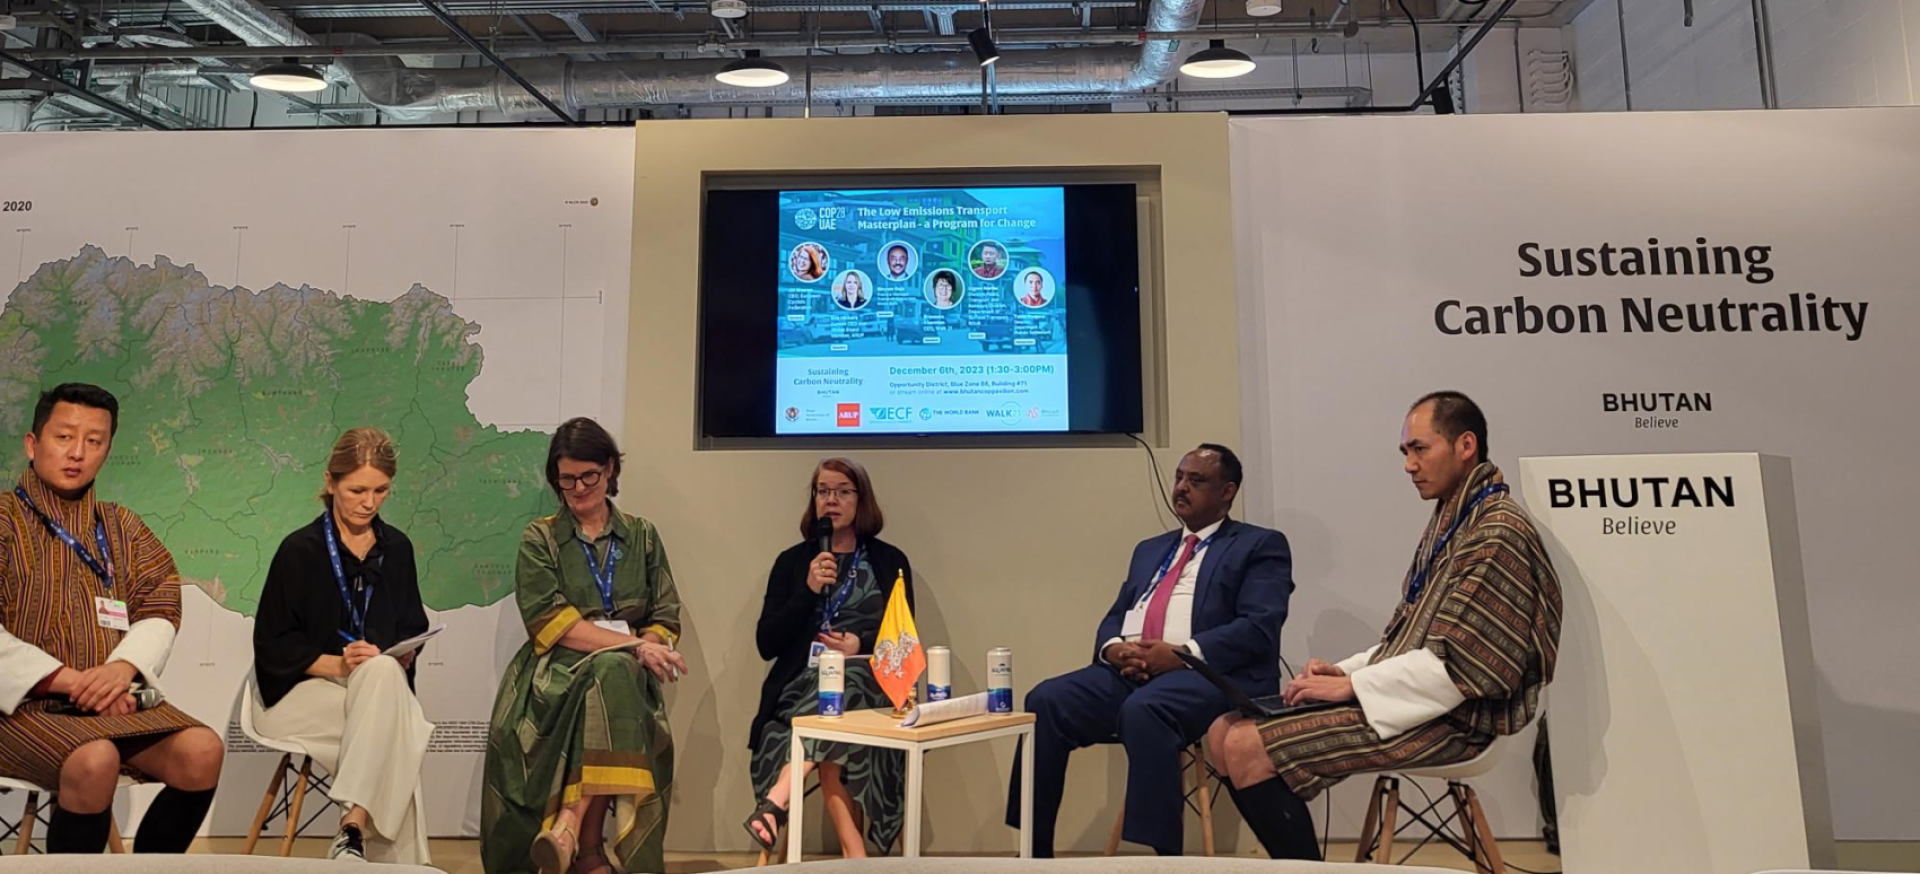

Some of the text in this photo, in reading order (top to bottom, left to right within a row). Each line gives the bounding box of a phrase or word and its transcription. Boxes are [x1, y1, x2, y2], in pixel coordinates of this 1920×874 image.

[2, 201, 33, 212] 2020
[857, 206, 1008, 217] The Low Emissions Transport
[819, 219, 837, 230] UAE
[858, 219, 916, 231] Masterplan
[933, 218, 978, 230] Program
[980, 219, 995, 228] for
[997, 218, 1037, 229] Change
[1517, 236, 1775, 285] Sustaining
[1434, 292, 1869, 342] Carbon Neutrality
[807, 367, 849, 377] Sustaining
[889, 365, 1055, 376] December 6th, 2023 (1:30-3:00PM)
[793, 377, 864, 387] Carbon Neutrality
[1602, 393, 1712, 412] BHUTAN
[887, 407, 912, 420] ECF
[1634, 416, 1679, 429] Believe
[1548, 476, 1735, 508] BHUTAN
[1602, 516, 1676, 535] Believe
